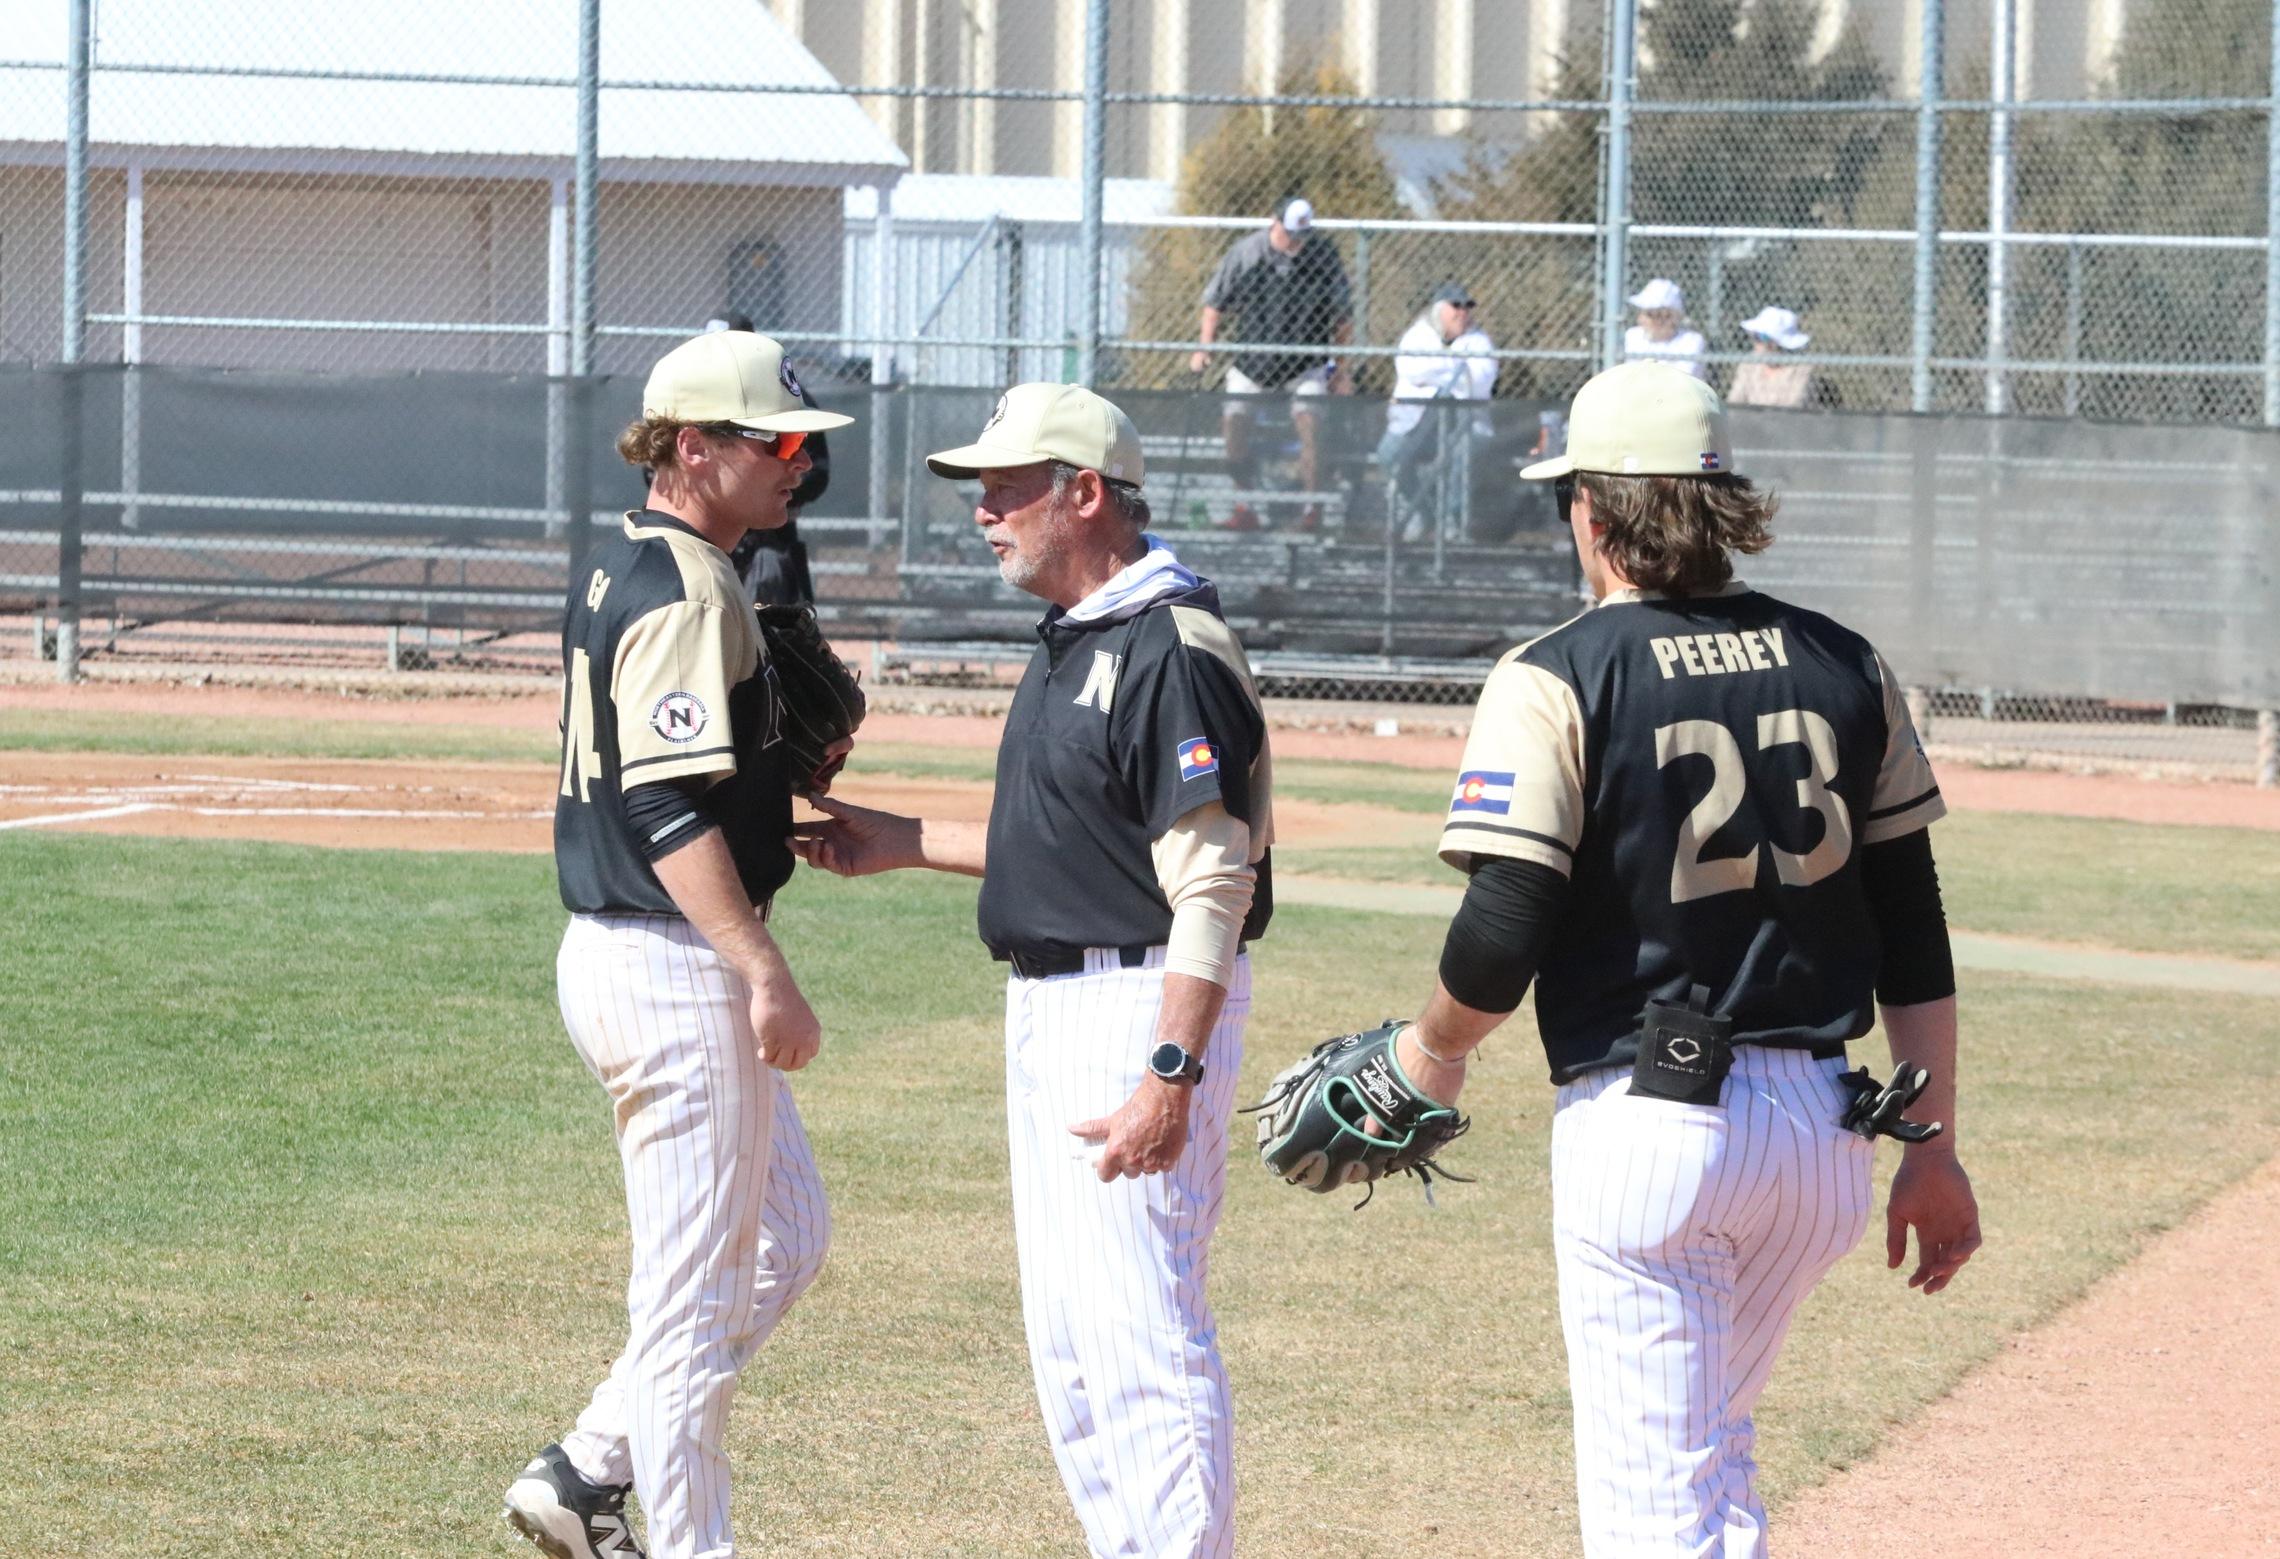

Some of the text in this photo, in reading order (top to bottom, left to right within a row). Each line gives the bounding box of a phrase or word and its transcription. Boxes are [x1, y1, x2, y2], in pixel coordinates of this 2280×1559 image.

[1650, 627, 1789, 679] PEEREY
[1073, 650, 1122, 714] N
[669, 707, 692, 728] N
[1655, 708, 1852, 904] 23
[1657, 1061, 1706, 1075] EVOSHIELD
